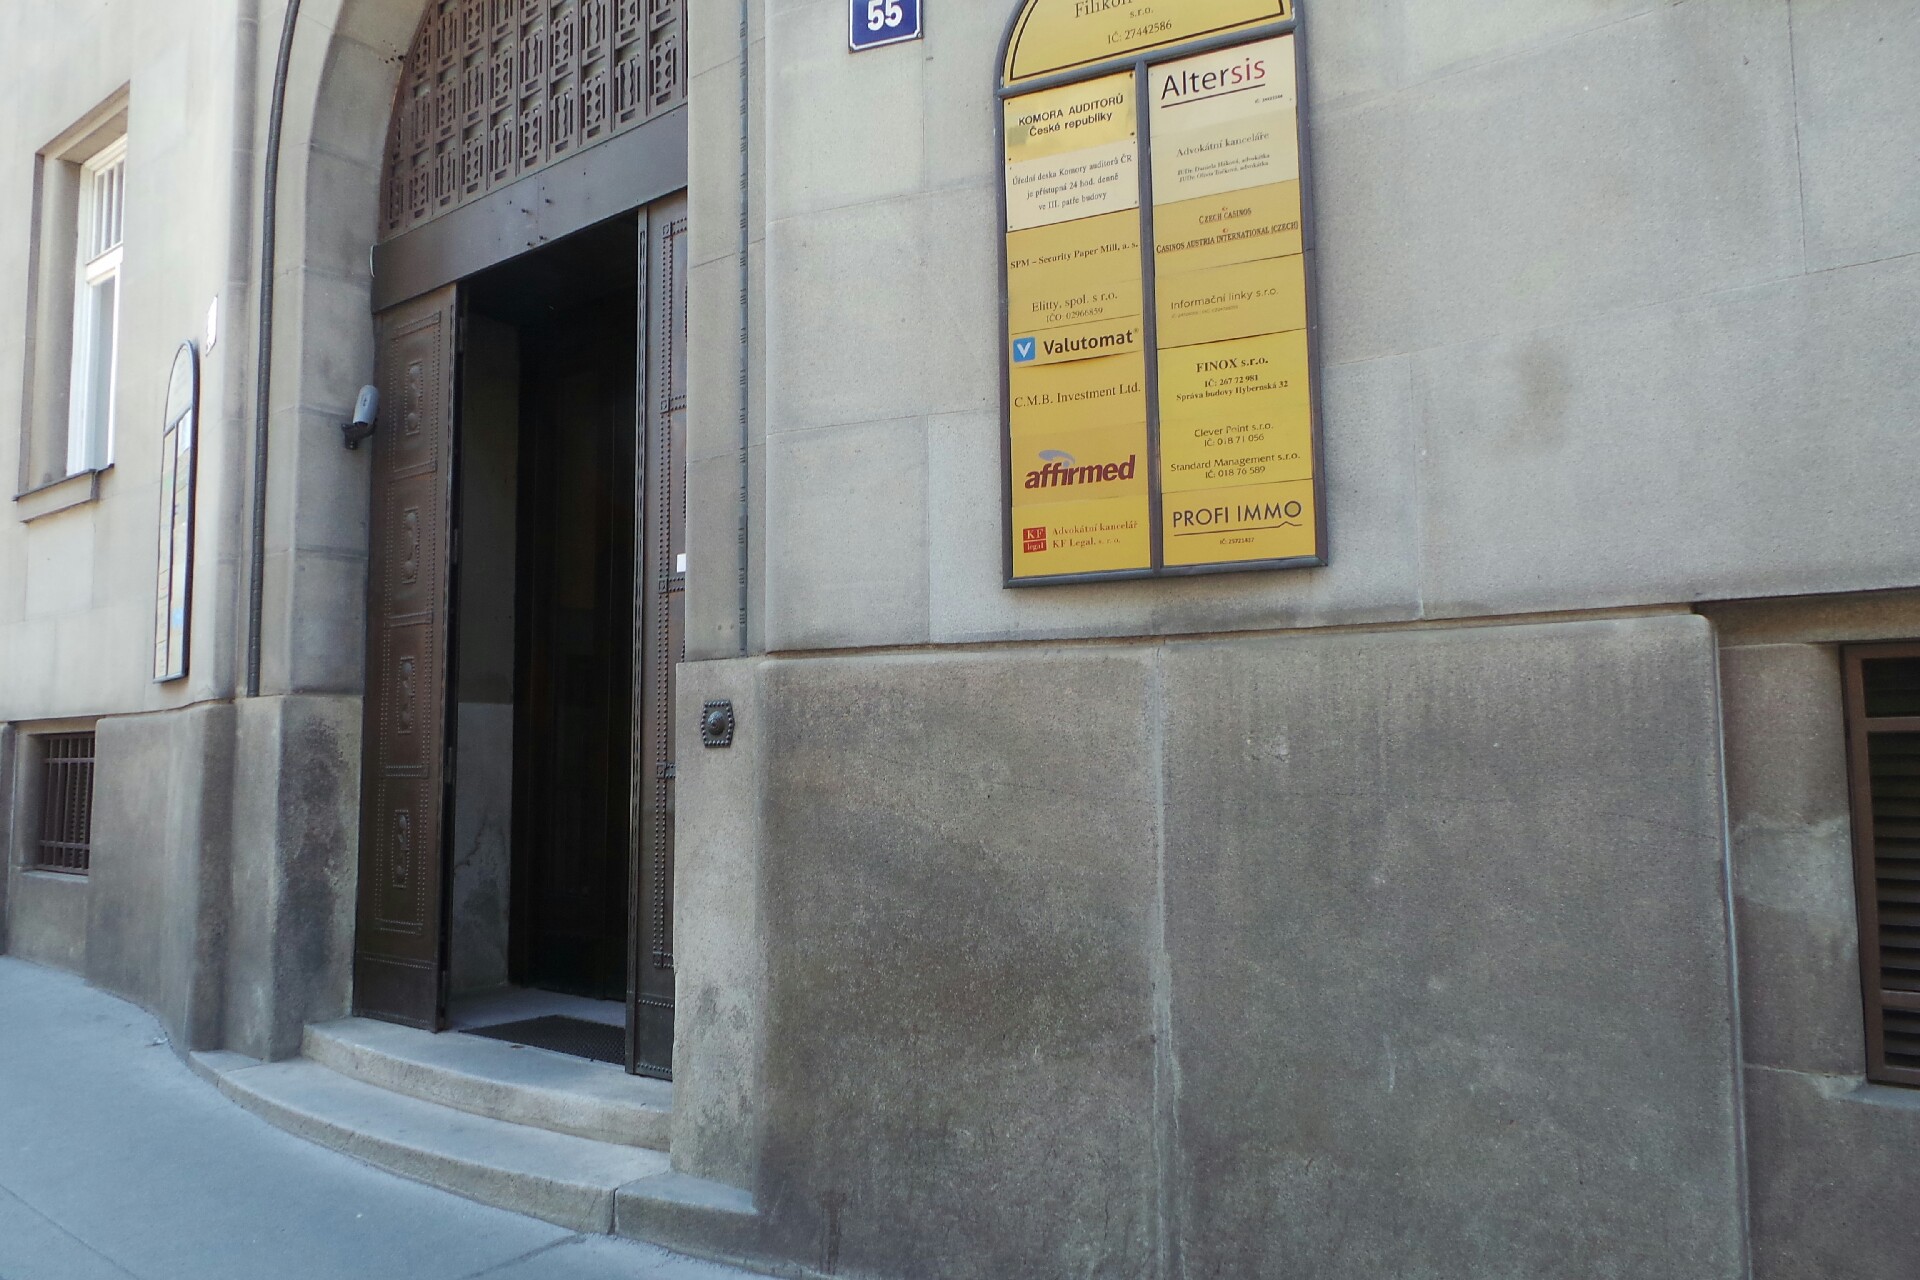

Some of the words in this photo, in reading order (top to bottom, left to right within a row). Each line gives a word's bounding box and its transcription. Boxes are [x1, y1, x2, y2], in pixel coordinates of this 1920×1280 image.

[868, 0, 902, 30] 55
[1130, 8, 1153, 18] s.r.o.
[1124, 19, 1172, 40] 27442586
[1161, 58, 1266, 100] Altersis
[1018, 109, 1064, 126] KOMORA
[1069, 93, 1124, 115] AUDITORŮ
[1029, 123, 1060, 136] České
[1064, 112, 1113, 129] republiky
[1176, 140, 1222, 158] Advokátní
[1225, 132, 1269, 147] kanceláře
[1038, 169, 1056, 180] deska
[1060, 165, 1086, 176] Komory
[1089, 157, 1118, 170] auditorů
[1120, 154, 1132, 163] ČR
[1069, 181, 1077, 189] 24
[1080, 178, 1095, 188] hod.
[1098, 173, 1119, 184] denně
[1081, 192, 1107, 202] budovy
[1198, 214, 1222, 224] CZECH
[1224, 208, 1252, 220] CASINOS
[1156, 241, 1185, 253] CASINOS
[1186, 235, 1215, 248] AUSTRIA
[1216, 226, 1270, 243] INTERNATIONAL
[1010, 259, 1030, 269] SPM
[1038, 253, 1071, 265] Security
[1074, 248, 1098, 258] Paper
[1101, 244, 1120, 253] Mill,
[1065, 294, 1089, 308] spol.
[1101, 293, 1117, 301] r.o.
[1171, 293, 1226, 310] Informační
[1228, 291, 1252, 301] linky
[1256, 288, 1278, 297] s.r.o.
[1196, 358, 1237, 373] FINOX
[1241, 357, 1268, 367] s.r.o.
[1176, 392, 1203, 402] Správa
[1205, 389, 1233, 397] budovy
[1236, 382, 1277, 394] Hybernská
[1279, 380, 1288, 388] 32
[1219, 377, 1232, 385] 267
[1014, 394, 1053, 407] C.M.B.
[1057, 386, 1116, 403] Investment
[1120, 382, 1141, 393] Ltd.
[1194, 428, 1223, 437] Clever
[1226, 425, 1249, 434] Point
[1248, 434, 1264, 442] 056
[1171, 460, 1211, 471] Standard
[1213, 454, 1275, 467] Management
[1278, 452, 1300, 461] s.r.o.
[1218, 469, 1234, 477] 018
[1250, 466, 1265, 474] 589
[1025, 455, 1135, 489] affirmed
[1173, 506, 1229, 528] PROFI
[1237, 501, 1302, 522] IMMO
[1053, 524, 1097, 535] Advokátní
[1027, 542, 1044, 551] legal
[1052, 540, 1066, 548] KF
